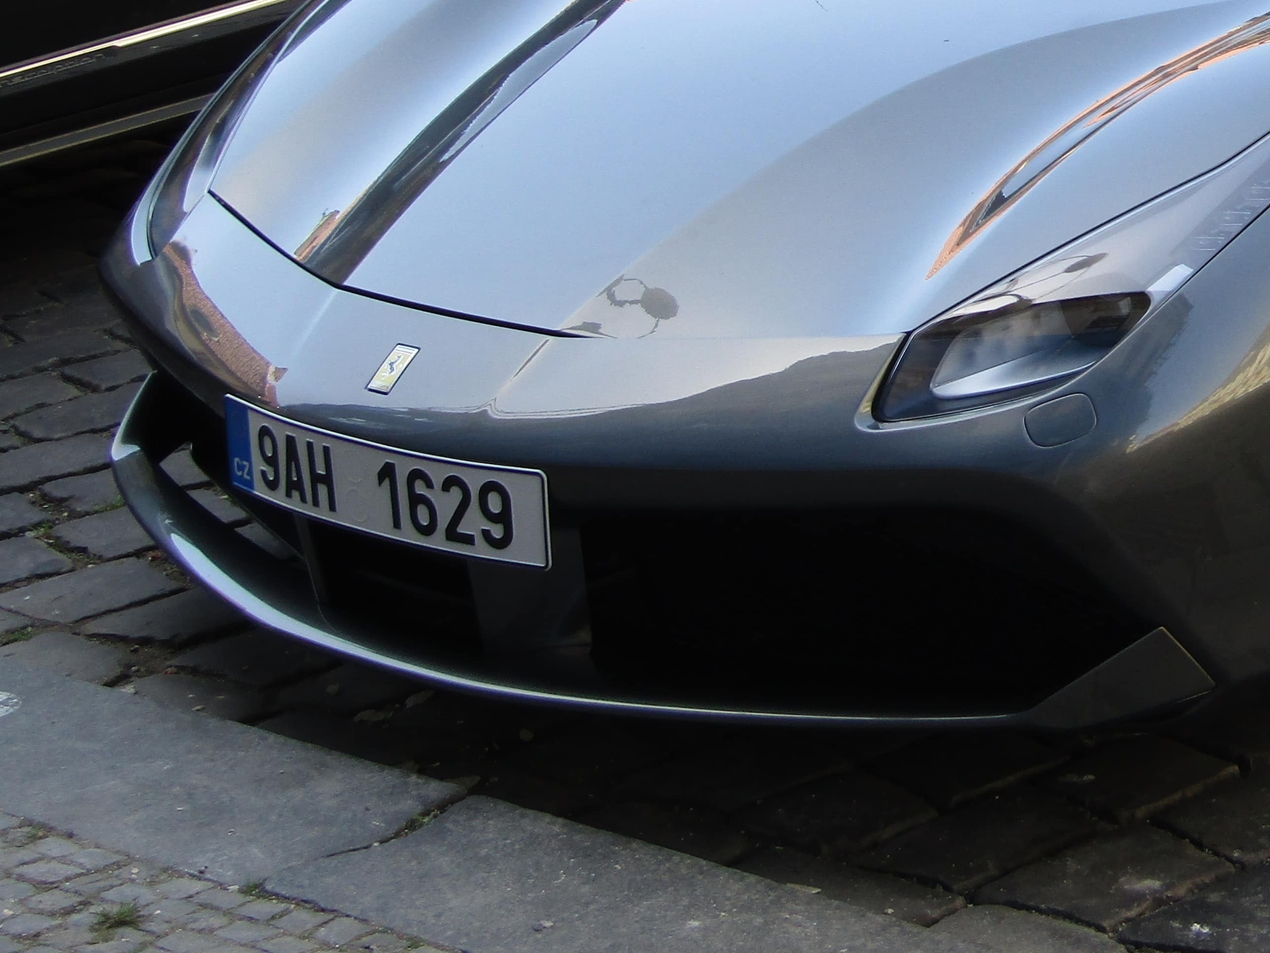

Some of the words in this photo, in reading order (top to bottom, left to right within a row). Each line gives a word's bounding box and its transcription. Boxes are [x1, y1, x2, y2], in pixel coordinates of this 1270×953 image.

[234, 457, 251, 480] CZ
[258, 425, 337, 512] 9AH
[377, 461, 514, 550] 1629
